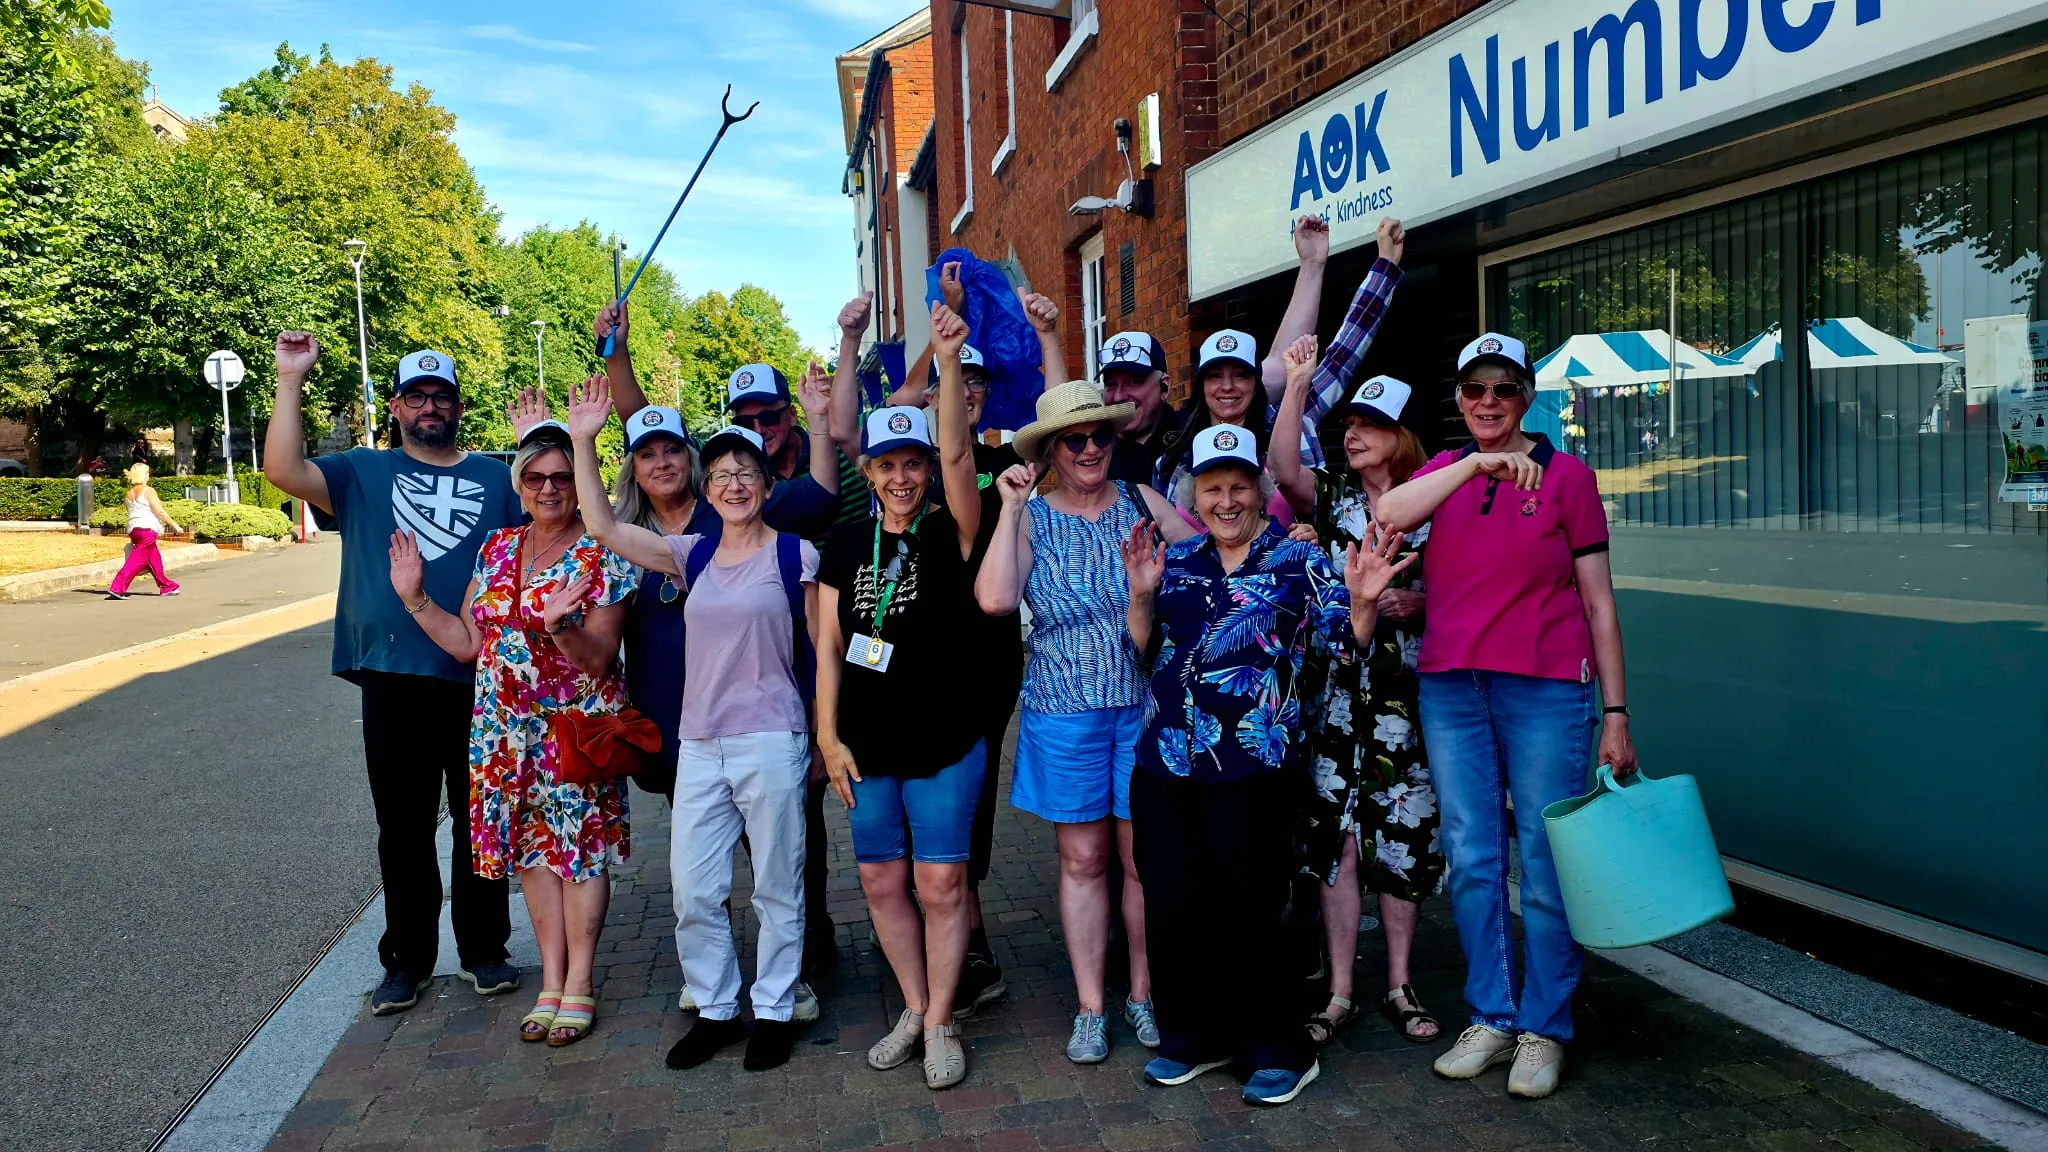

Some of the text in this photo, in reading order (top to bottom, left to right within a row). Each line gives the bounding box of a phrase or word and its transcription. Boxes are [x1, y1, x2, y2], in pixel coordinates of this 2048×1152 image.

[1290, 89, 1391, 212] AOK
[1448, 0, 1881, 178] Numb
[872, 644, 880, 654] 6
